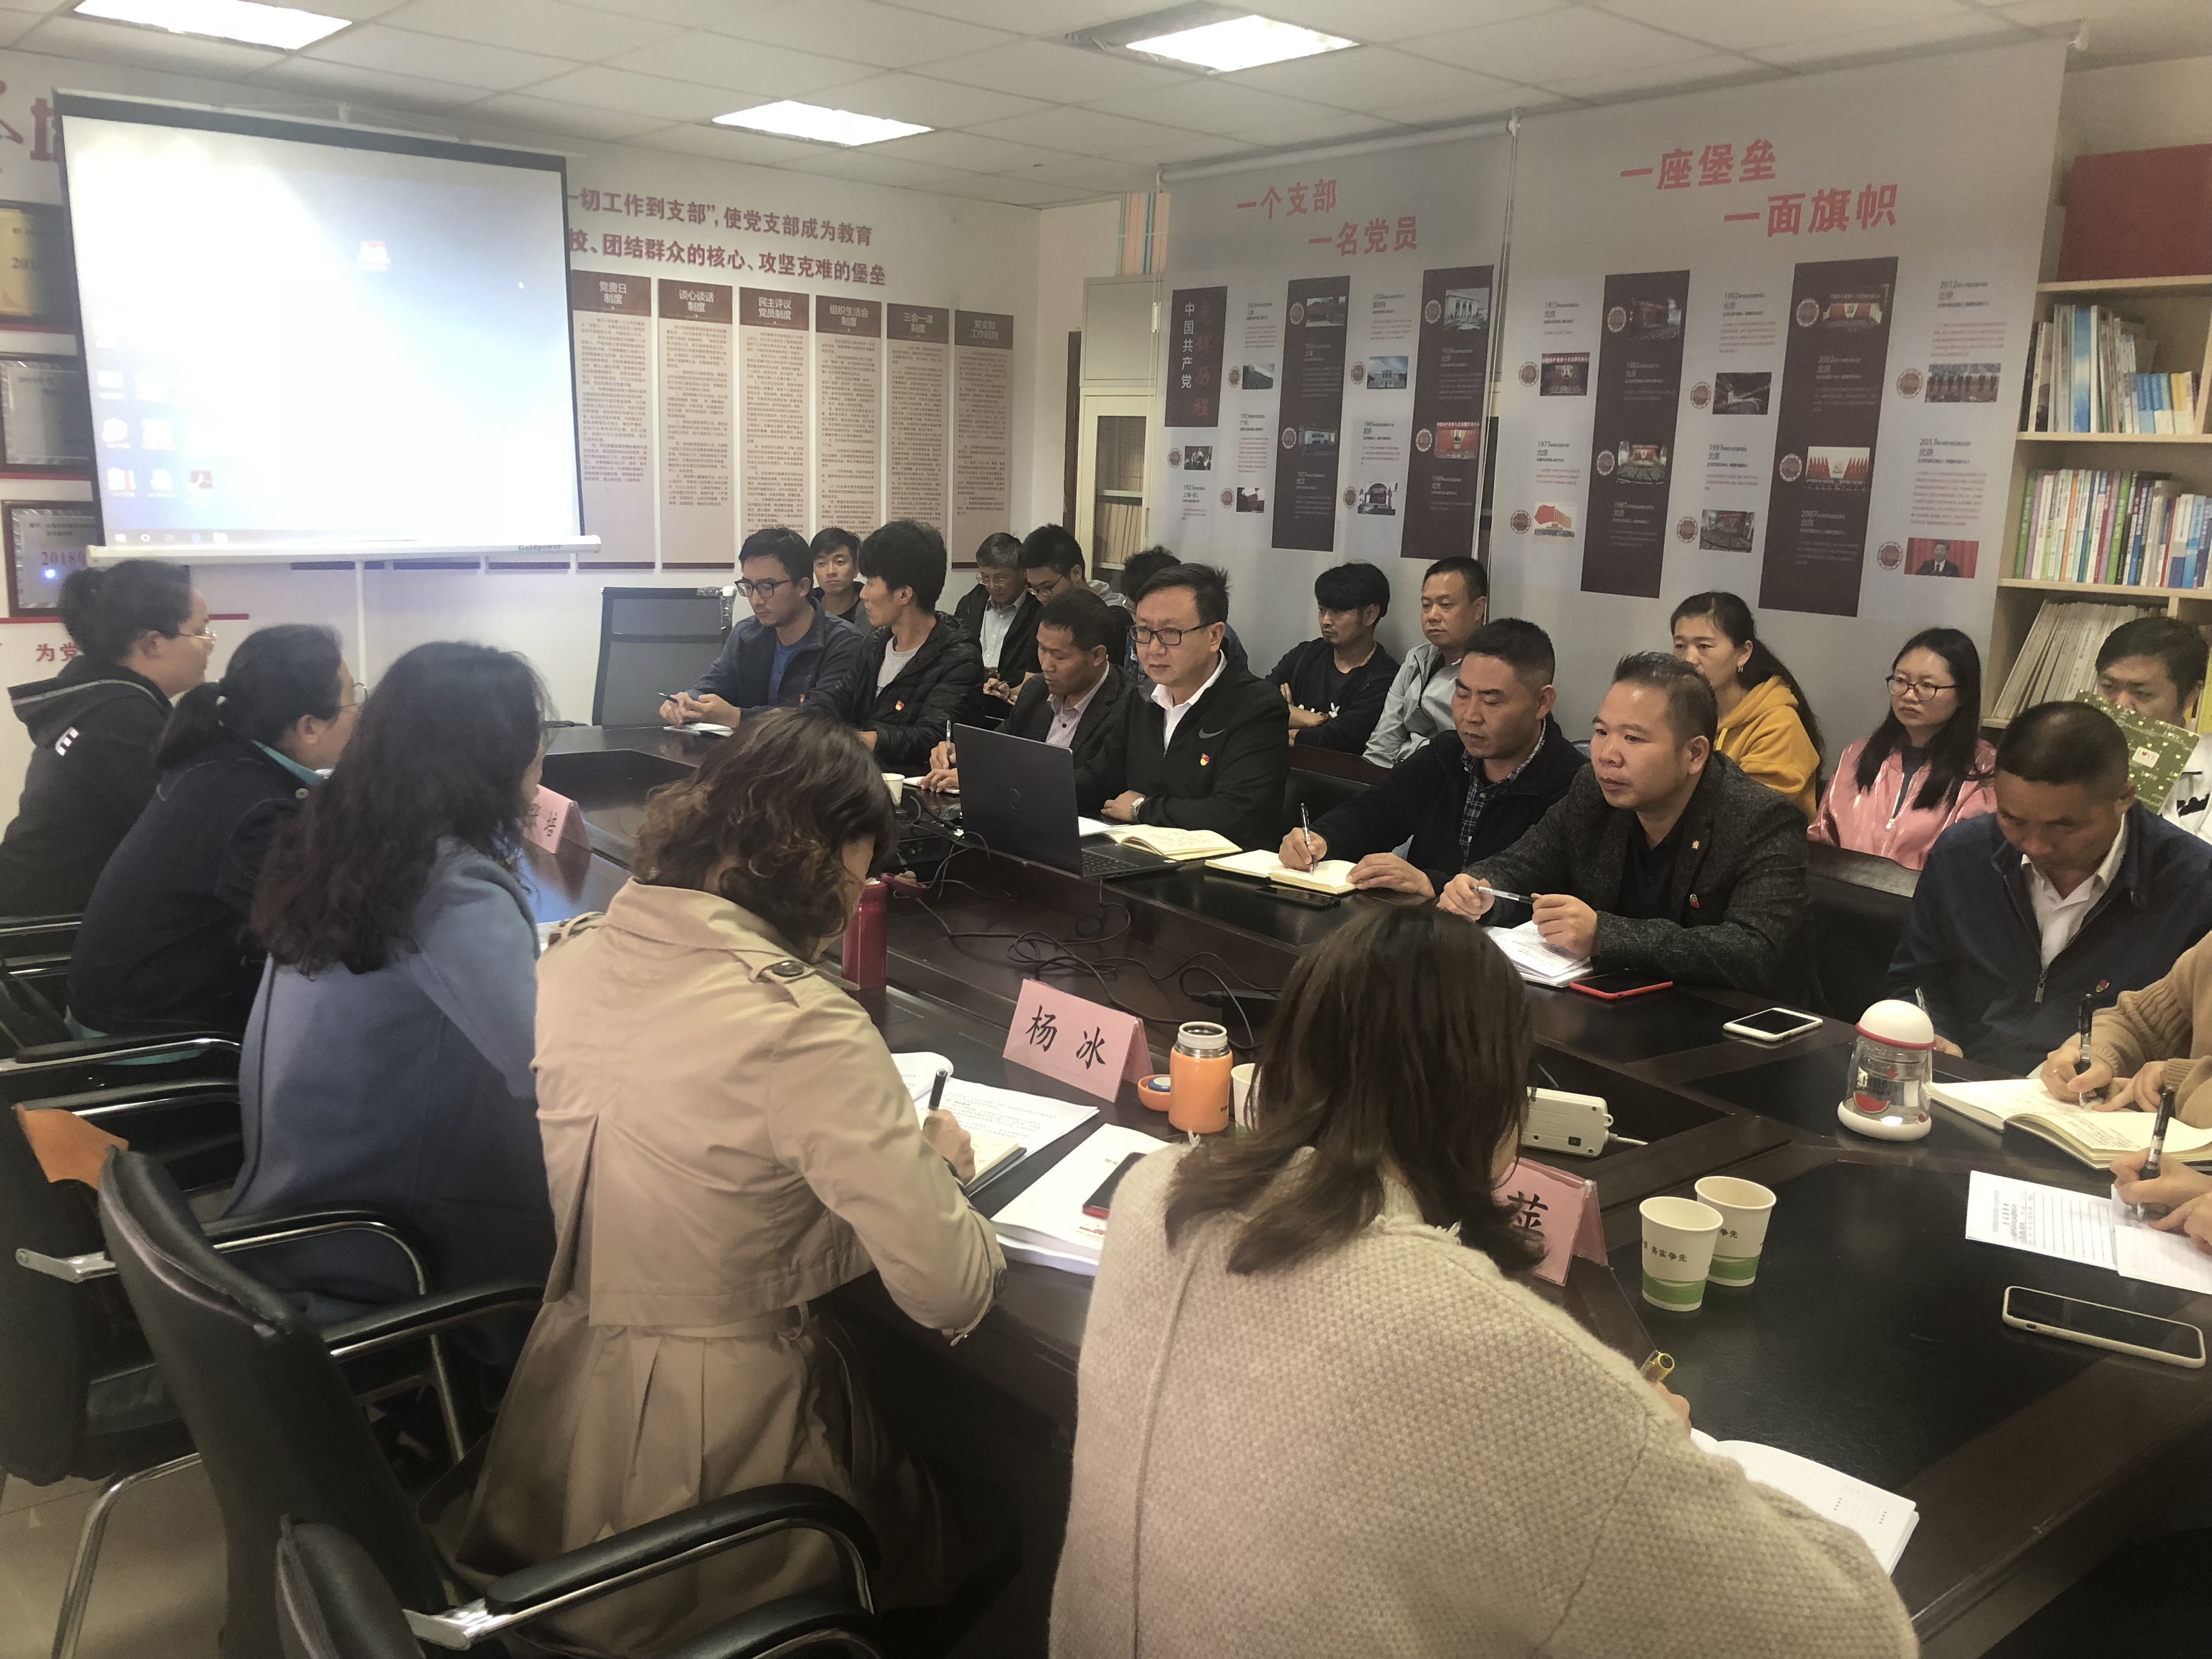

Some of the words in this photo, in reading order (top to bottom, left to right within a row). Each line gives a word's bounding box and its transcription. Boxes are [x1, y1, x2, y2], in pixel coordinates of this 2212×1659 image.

[1620, 138, 1776, 190] 一座堡垒
[1237, 179, 1337, 219] 一个支部
[1724, 183, 1898, 237] 一面旗帜
[1308, 216, 1417, 257] 一名党员
[600, 281, 627, 294] 党费日
[604, 293, 623, 305] 制度
[679, 290, 715, 302] 谈心谈话
[688, 301, 706, 313] 制度
[759, 297, 792, 309] 民主评议
[758, 308, 792, 320] 党员制度
[830, 304, 869, 318] 组织生活会
[841, 317, 857, 327] 制度
[903, 312, 933, 324] 三会一课
[911, 323, 926, 334] 制度
[1181, 301, 1195, 389] 中国共产党
[1025, 1005, 1106, 1069] 杨冰
